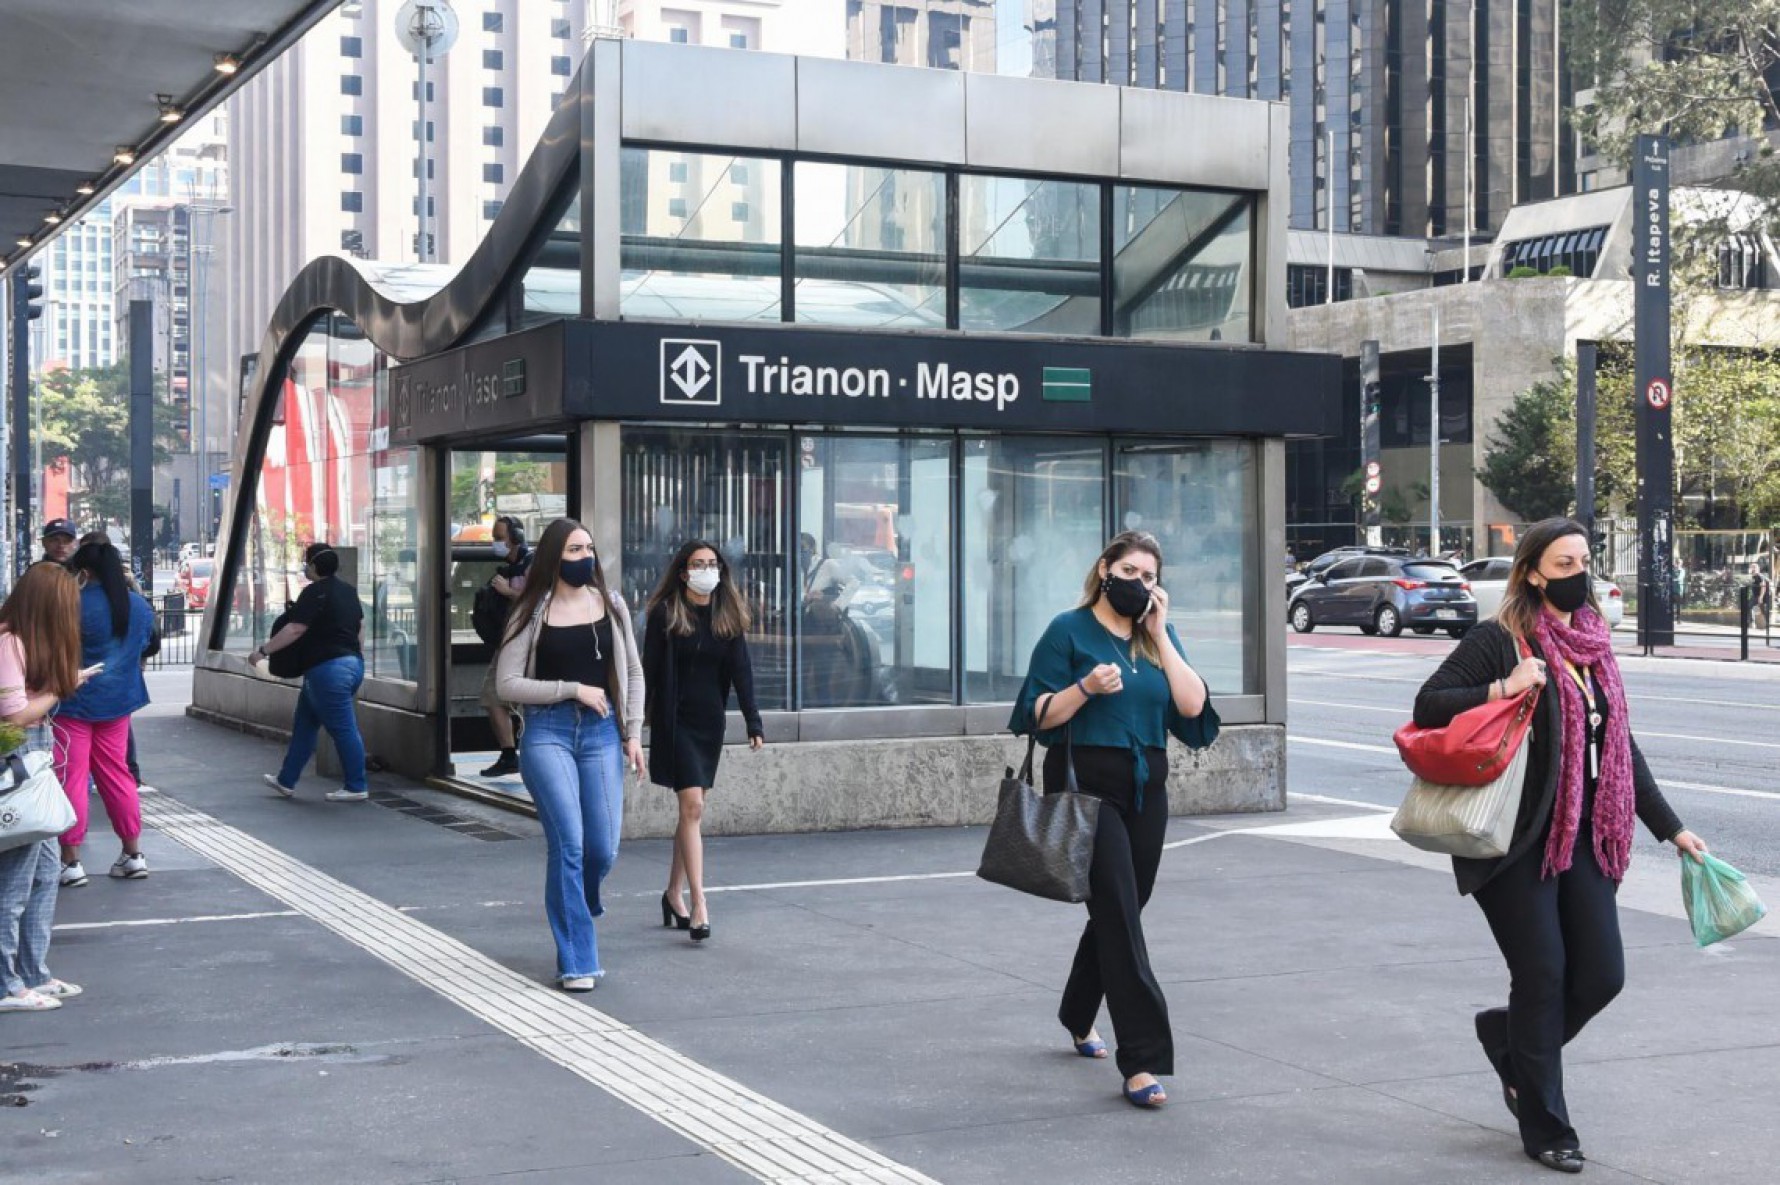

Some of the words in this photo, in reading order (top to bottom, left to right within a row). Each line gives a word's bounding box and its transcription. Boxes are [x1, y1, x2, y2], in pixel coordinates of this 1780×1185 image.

[1647, 189, 1662, 262] Itapeva
[1647, 270, 1660, 286] R.
[739, 355, 890, 397] Trianon
[917, 362, 1020, 411] Masp
